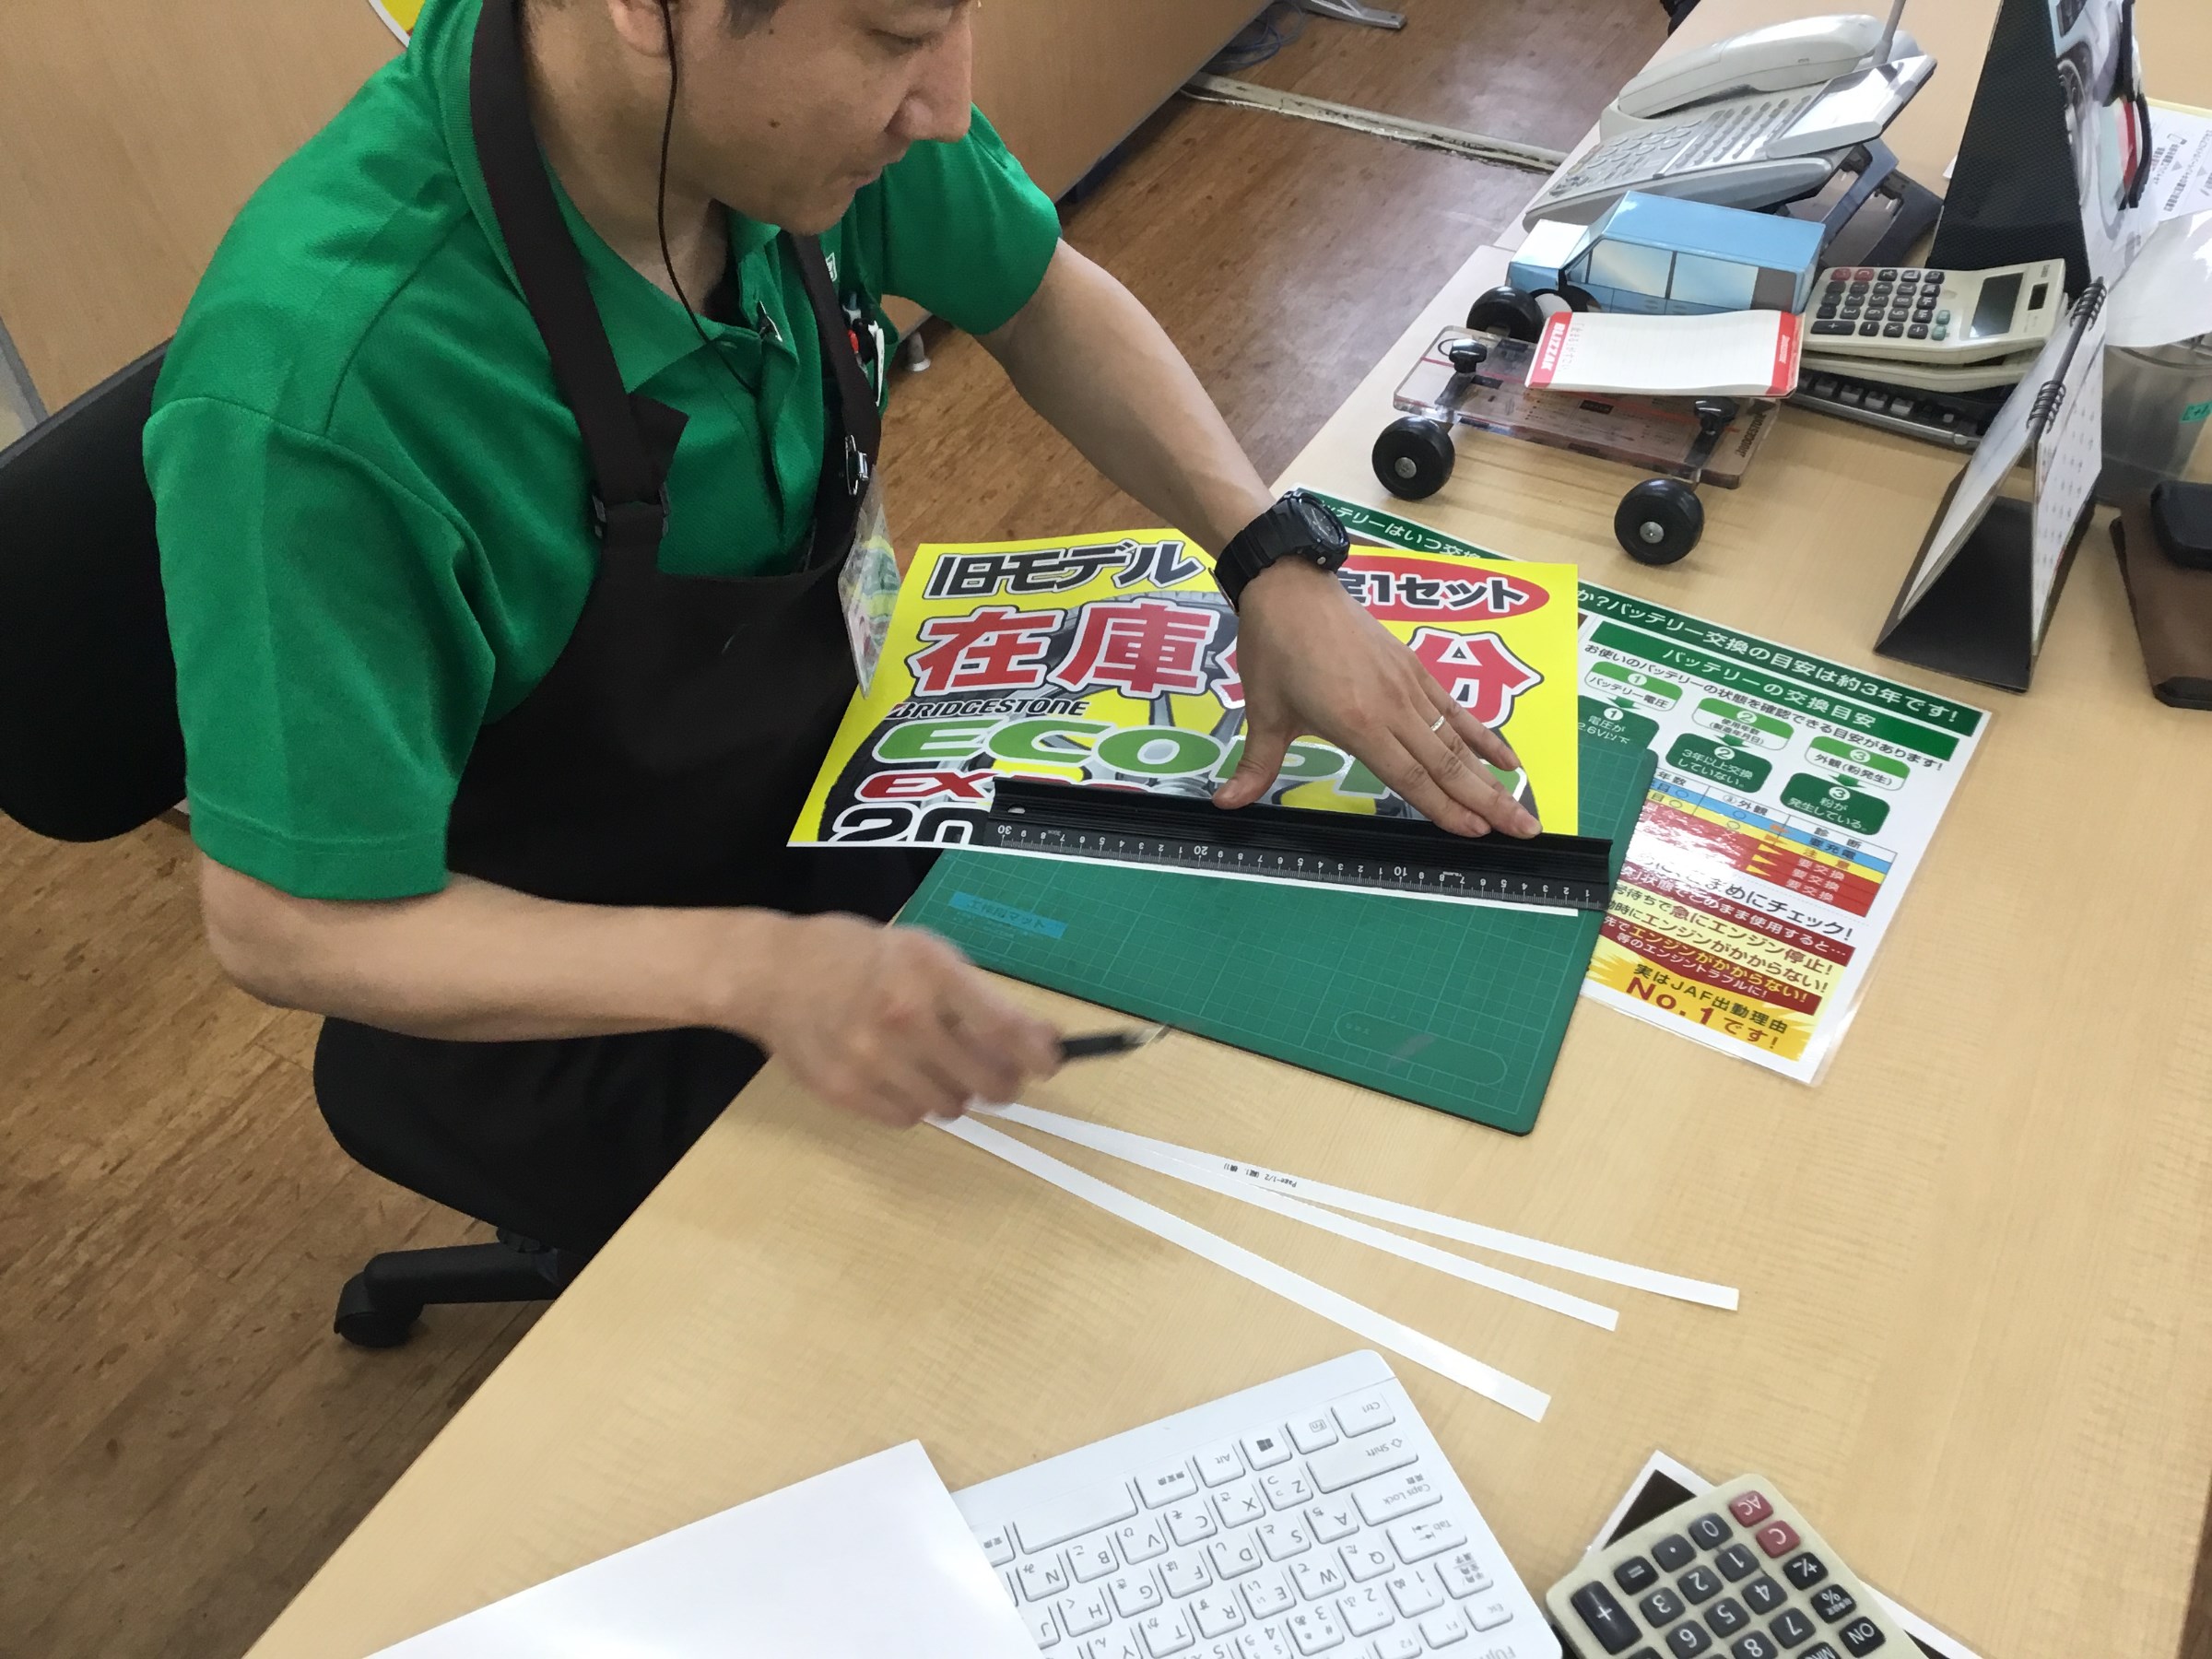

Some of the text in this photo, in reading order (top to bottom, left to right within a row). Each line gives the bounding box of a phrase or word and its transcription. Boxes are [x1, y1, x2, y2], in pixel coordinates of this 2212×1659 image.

[1540, 322, 1565, 372] BLIZZAK
[922, 538, 1205, 599] 旧モデル
[905, 597, 1545, 729] 在庫分
[1589, 676, 1669, 710] バッテリー電圧
[1662, 649, 1877, 729] バッテリーの交換目安
[886, 698, 1091, 719] BRIDGESTONE
[1588, 715, 1627, 733] 電圧が
[1682, 749, 1753, 780] 3年以上交換
[1814, 753, 1893, 786] 外観(粉発生)
[1819, 797, 1848, 811] 粉が
[997, 824, 1013, 835] 30
[1193, 845, 1208, 856] 20
[1394, 865, 1407, 877] 10
[1799, 857, 1845, 881] 要交換
[1792, 868, 1841, 892] 要交換
[1785, 878, 1834, 902] 要交換
[1617, 932, 1769, 998] 等のエンジントラブルに!
[1633, 963, 1788, 1034] 実はJAF出動理由
[1264, 1173, 1298, 1188] Page-1/2
[1362, 1401, 1381, 1414] Ctrl
[1365, 1442, 1390, 1457] Shift
[1215, 1453, 1230, 1465] Alt
[1291, 1479, 1305, 1493] Z
[1382, 1483, 1431, 1505] Caps Lock
[1241, 1498, 1257, 1512] X
[1737, 1495, 1761, 1515] AC
[1194, 1515, 1208, 1528] C
[1334, 1512, 1347, 1525] A
[1434, 1519, 1453, 1532] Tab
[1147, 1534, 1161, 1547] V
[1290, 1530, 1302, 1544] S
[1769, 1528, 1787, 1546] C
[1098, 1550, 1111, 1564] B
[1239, 1547, 1253, 1561] D
[1369, 1551, 1385, 1564] Q
[1726, 1552, 1745, 1568] 1
[1045, 1570, 1060, 1584] N
[1194, 1566, 1204, 1580] F
[1320, 1569, 1337, 1584] W
[1688, 1572, 1709, 1592] 2
[1139, 1585, 1153, 1599] G
[1274, 1586, 1288, 1601] E
[1364, 1588, 1377, 1602] 2
[1754, 1585, 1770, 1601] 4
[1088, 1604, 1103, 1618] H
[1653, 1594, 1671, 1613] 3
[1222, 1606, 1237, 1619] R
[1314, 1606, 1327, 1620] 3
[1717, 1605, 1736, 1624] 5
[1041, 1622, 1050, 1637] J
[1174, 1625, 1186, 1639] T
[1785, 1617, 1803, 1636] 7
[1847, 1623, 1875, 1644] ON
[1264, 1628, 1276, 1641] 4
[1680, 1629, 1698, 1648] 6
[1744, 1639, 1763, 1657] 8
